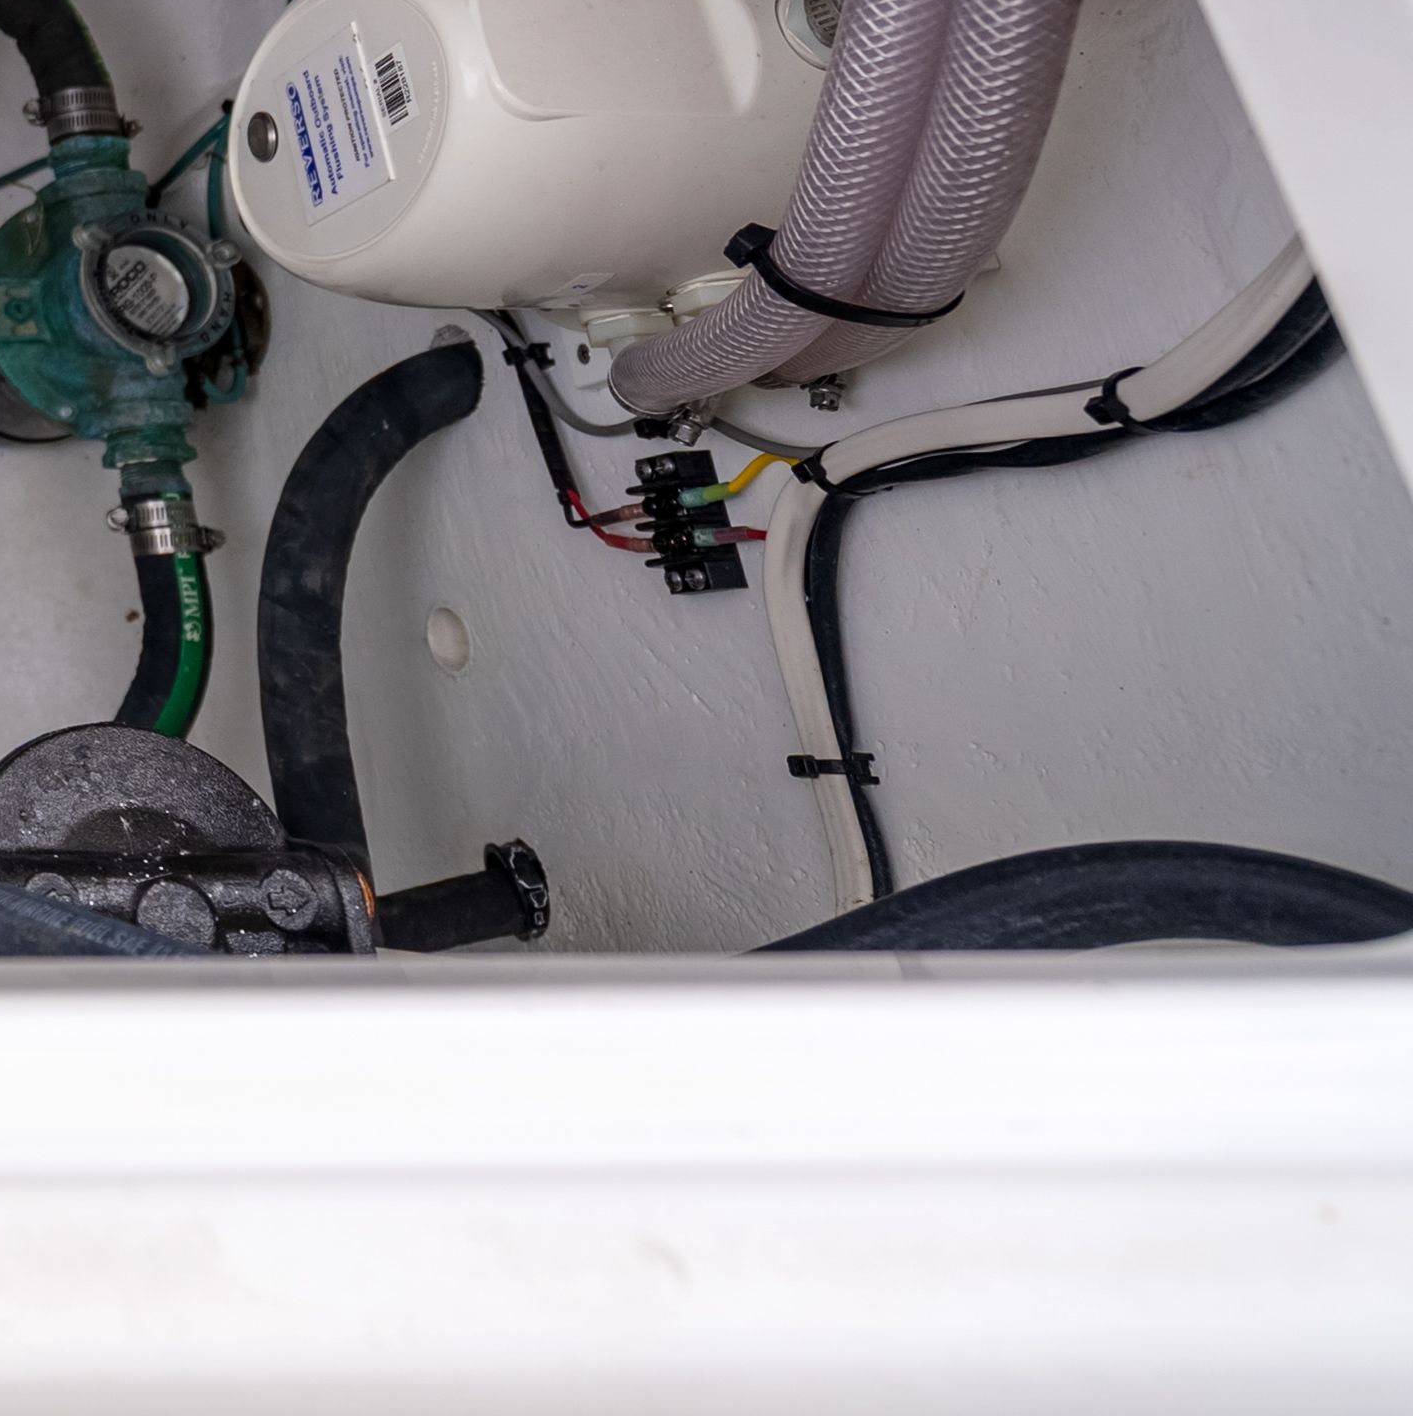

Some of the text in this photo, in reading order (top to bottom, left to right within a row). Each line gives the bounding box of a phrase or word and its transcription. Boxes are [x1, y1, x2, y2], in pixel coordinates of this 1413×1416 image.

[301, 69, 338, 194] Automatic Outboard
[312, 74, 344, 180] Flushing System
[332, 67, 360, 162] IGNITION PROTECTED
[351, 110, 366, 151] operating
[374, 86, 387, 117] SERIAL
[285, 82, 323, 206] REVERSO
[361, 152, 370, 168] For
[180, 575, 200, 616] MPI
